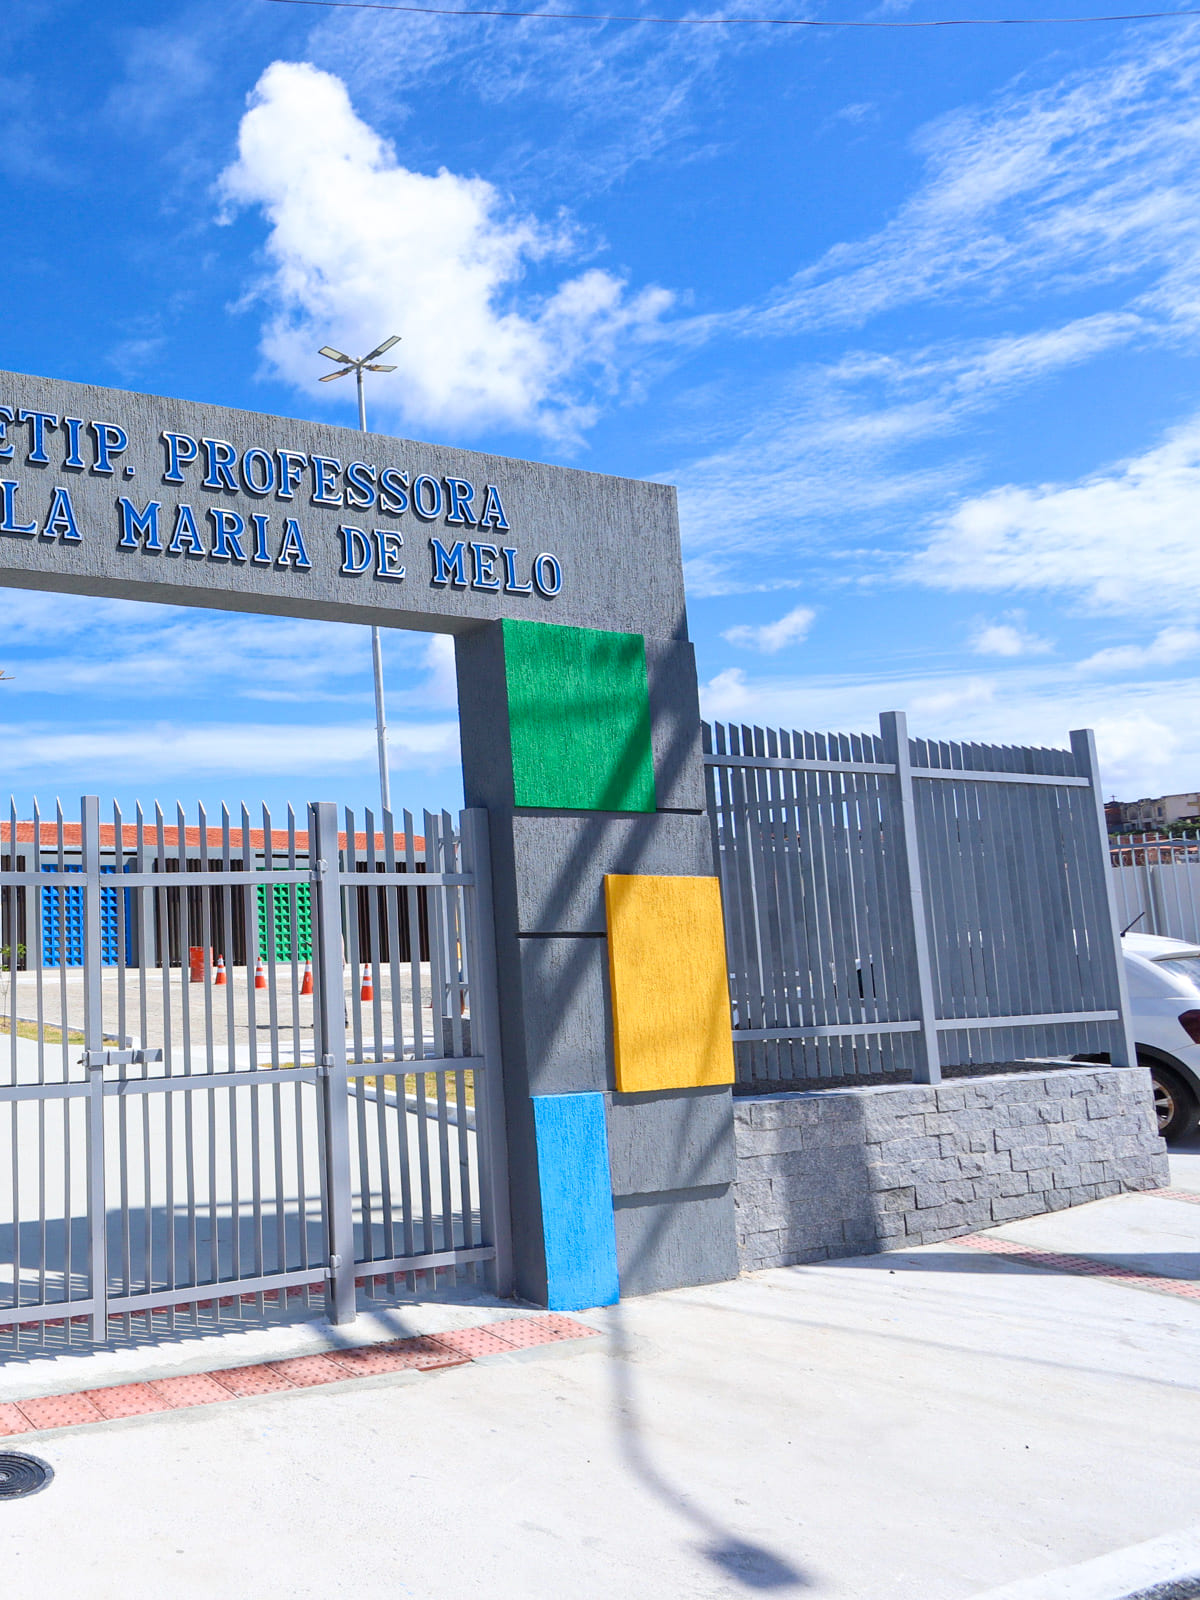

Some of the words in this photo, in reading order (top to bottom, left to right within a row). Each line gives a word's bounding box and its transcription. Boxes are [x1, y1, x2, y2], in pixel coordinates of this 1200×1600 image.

[163, 430, 511, 530] PROFESSORA
[118, 496, 312, 568] MARIA
[340, 524, 406, 580] DE
[431, 537, 563, 596] MELO
